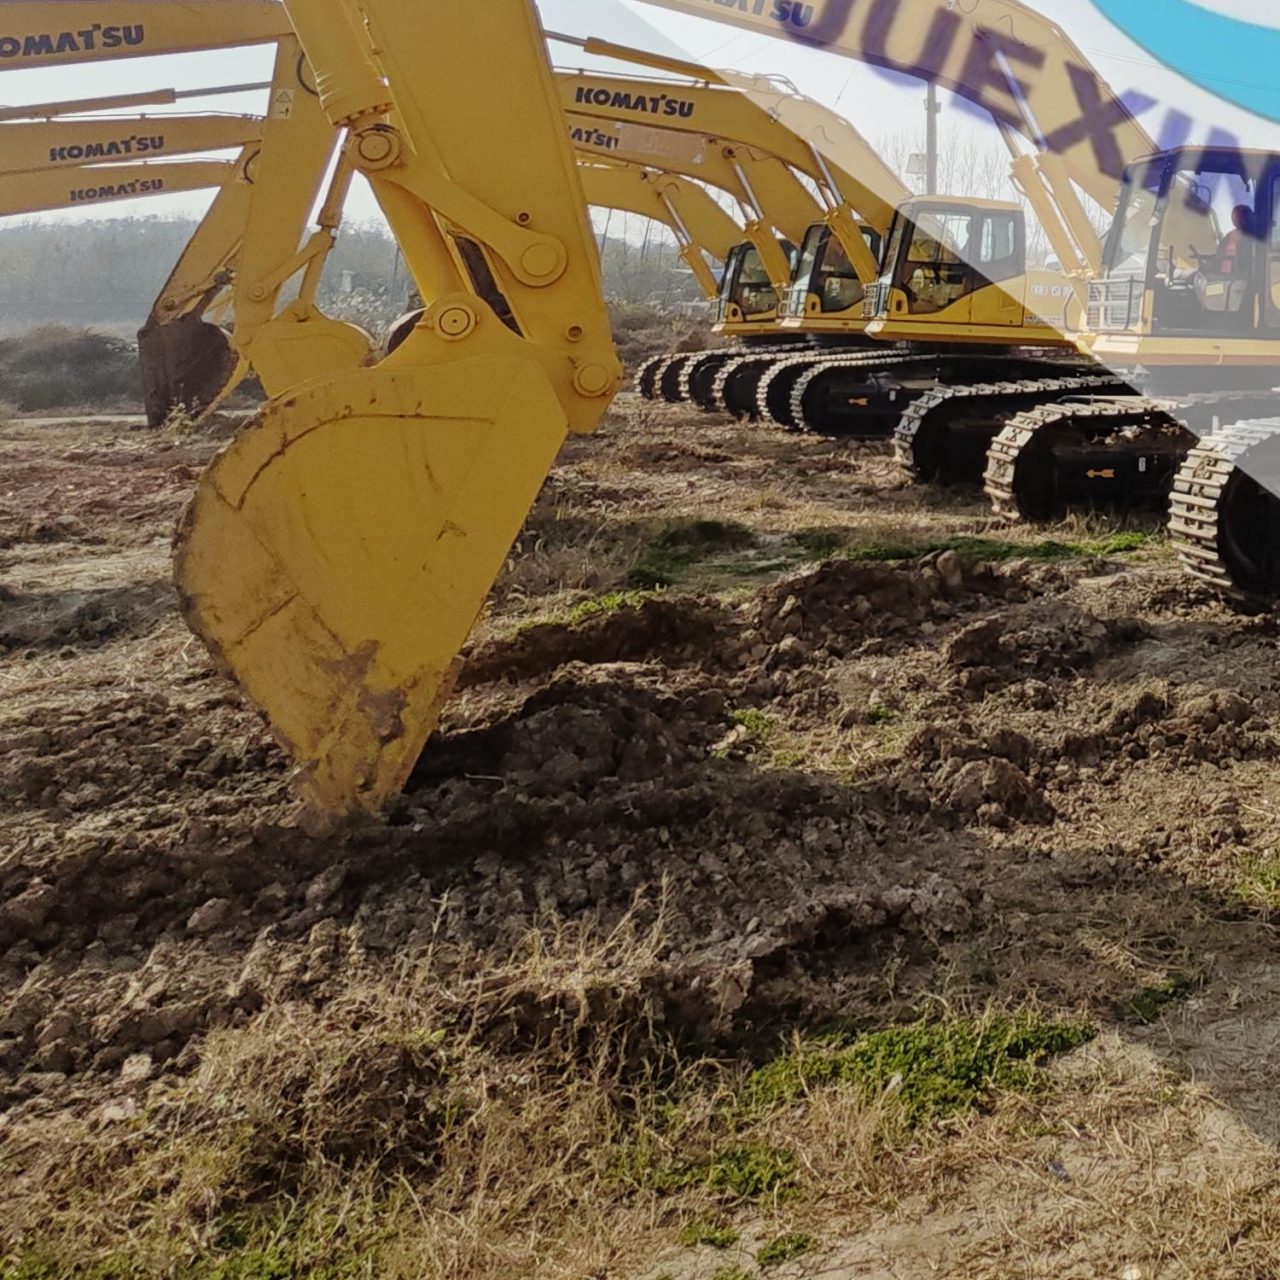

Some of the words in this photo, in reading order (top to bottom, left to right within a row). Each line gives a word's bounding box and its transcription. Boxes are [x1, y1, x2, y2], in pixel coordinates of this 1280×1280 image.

[575, 86, 694, 118] KOMATSU
[49, 135, 164, 161] KOMATSU
[70, 179, 163, 201] KOMATSU
